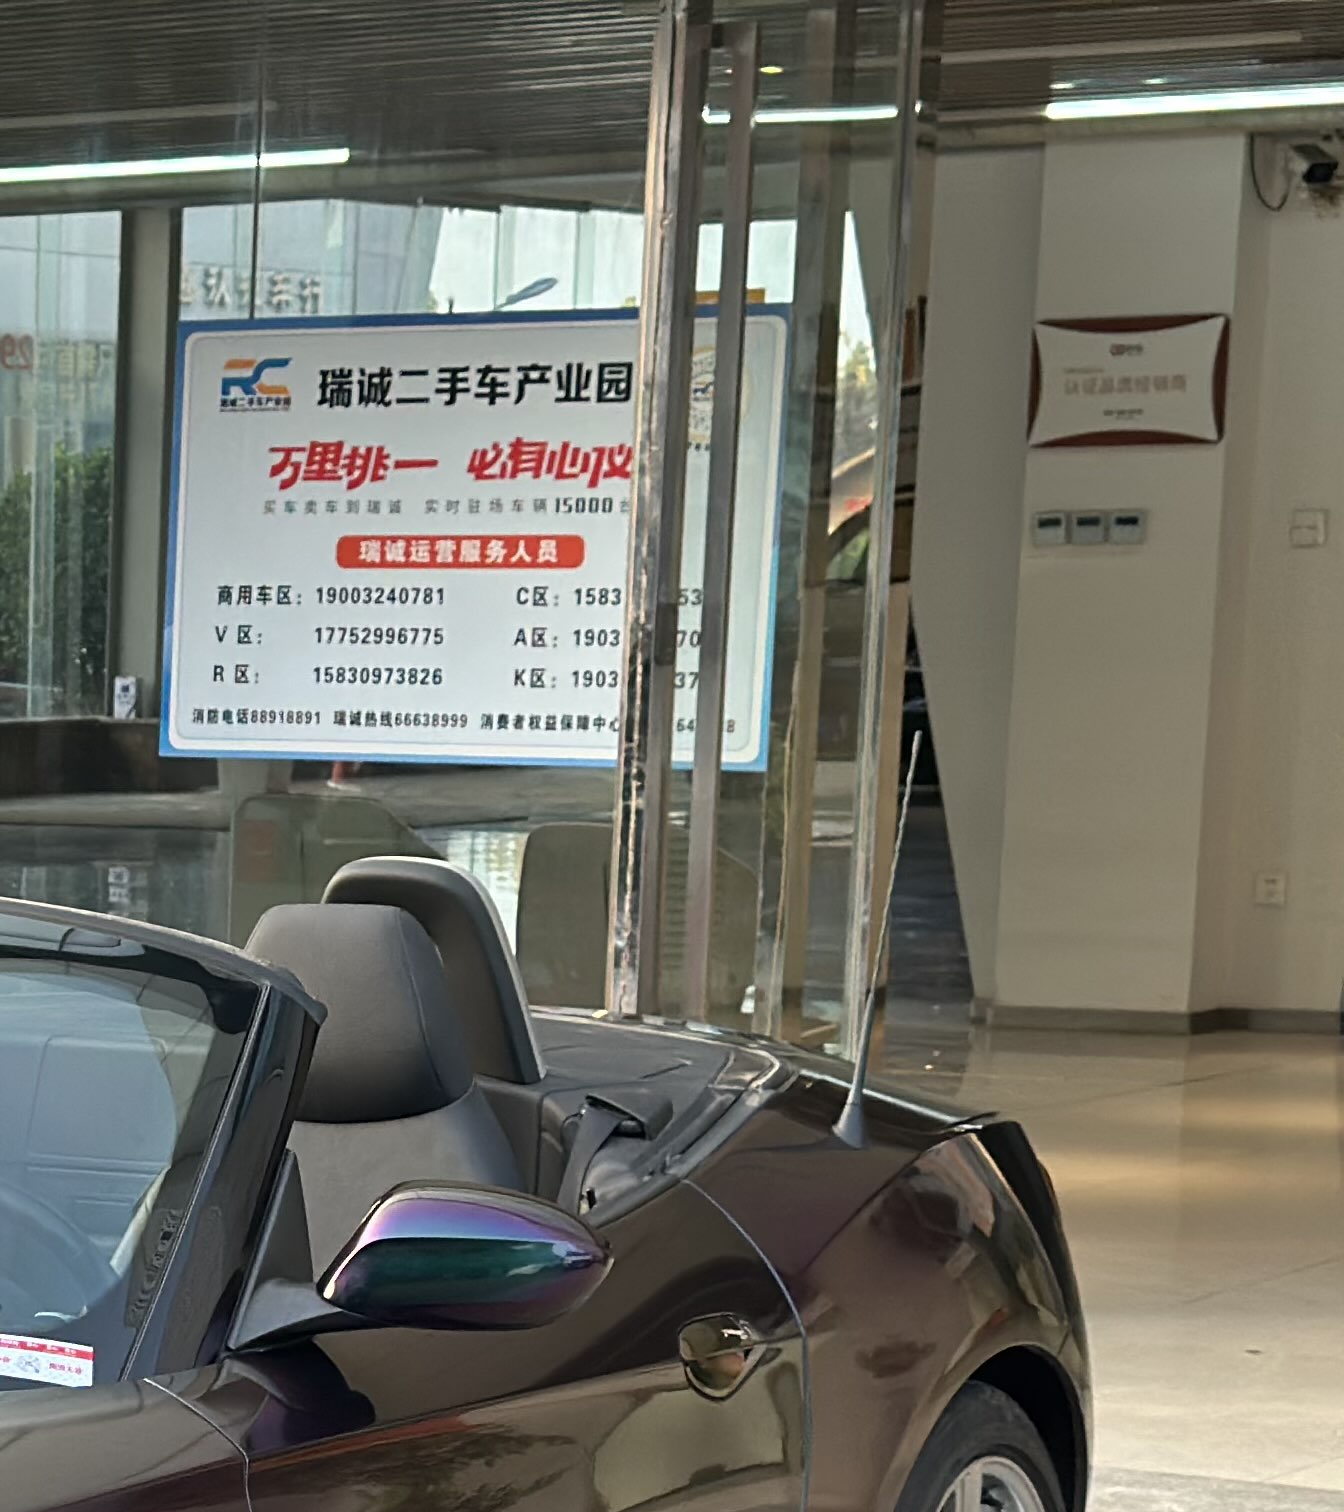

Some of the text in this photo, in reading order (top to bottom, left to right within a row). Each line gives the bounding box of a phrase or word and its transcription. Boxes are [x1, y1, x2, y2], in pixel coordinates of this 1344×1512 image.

[317, 361, 633, 408] 瑞诚二手车产业园
[267, 436, 633, 491] 万里挑一 必有心仪
[263, 499, 403, 515] 买车卖车到瑞诚
[358, 538, 559, 564] 瑞诚运营服务人员
[217, 584, 444, 606] 商用车区： 19003240781
[314, 627, 444, 645] 17752996775
[313, 666, 443, 686] 15830973826
[332, 709, 468, 729] 瑞诚热线66638999
